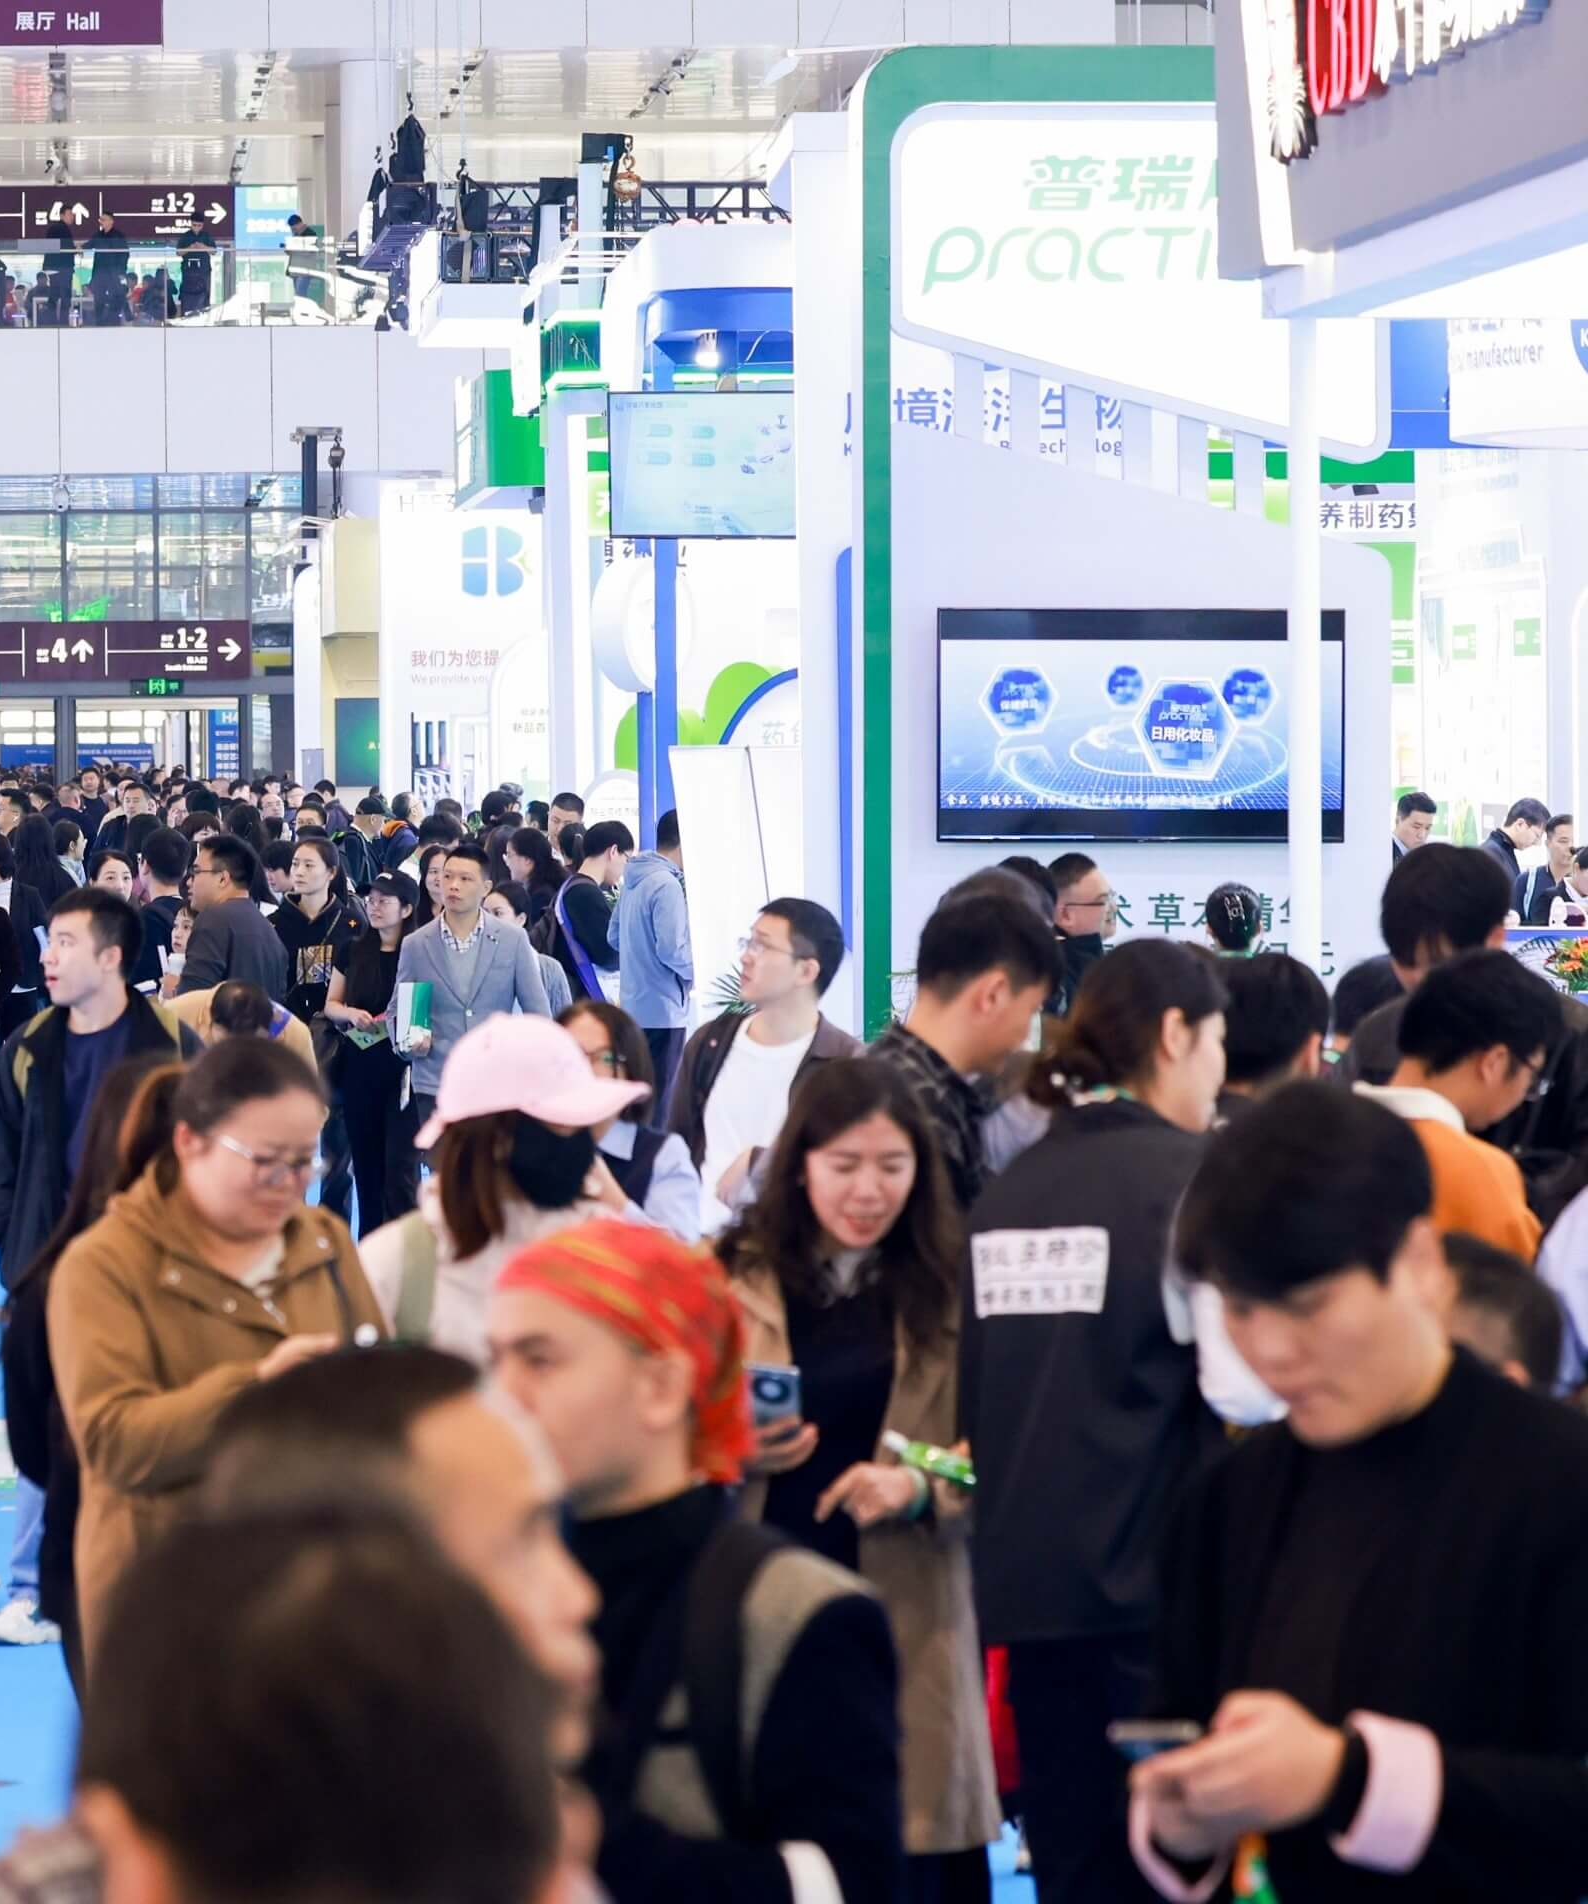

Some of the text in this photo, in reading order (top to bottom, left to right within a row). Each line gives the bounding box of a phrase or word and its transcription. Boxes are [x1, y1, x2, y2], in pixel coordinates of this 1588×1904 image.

[14, 11, 101, 32] 展厅 Hall
[167, 191, 196, 214] 1-2
[176, 626, 208, 649] 1-2
[51, 637, 69, 663] 4
[411, 649, 500, 668] 我们为您提
[1151, 726, 1216, 743] 日用化妆品
